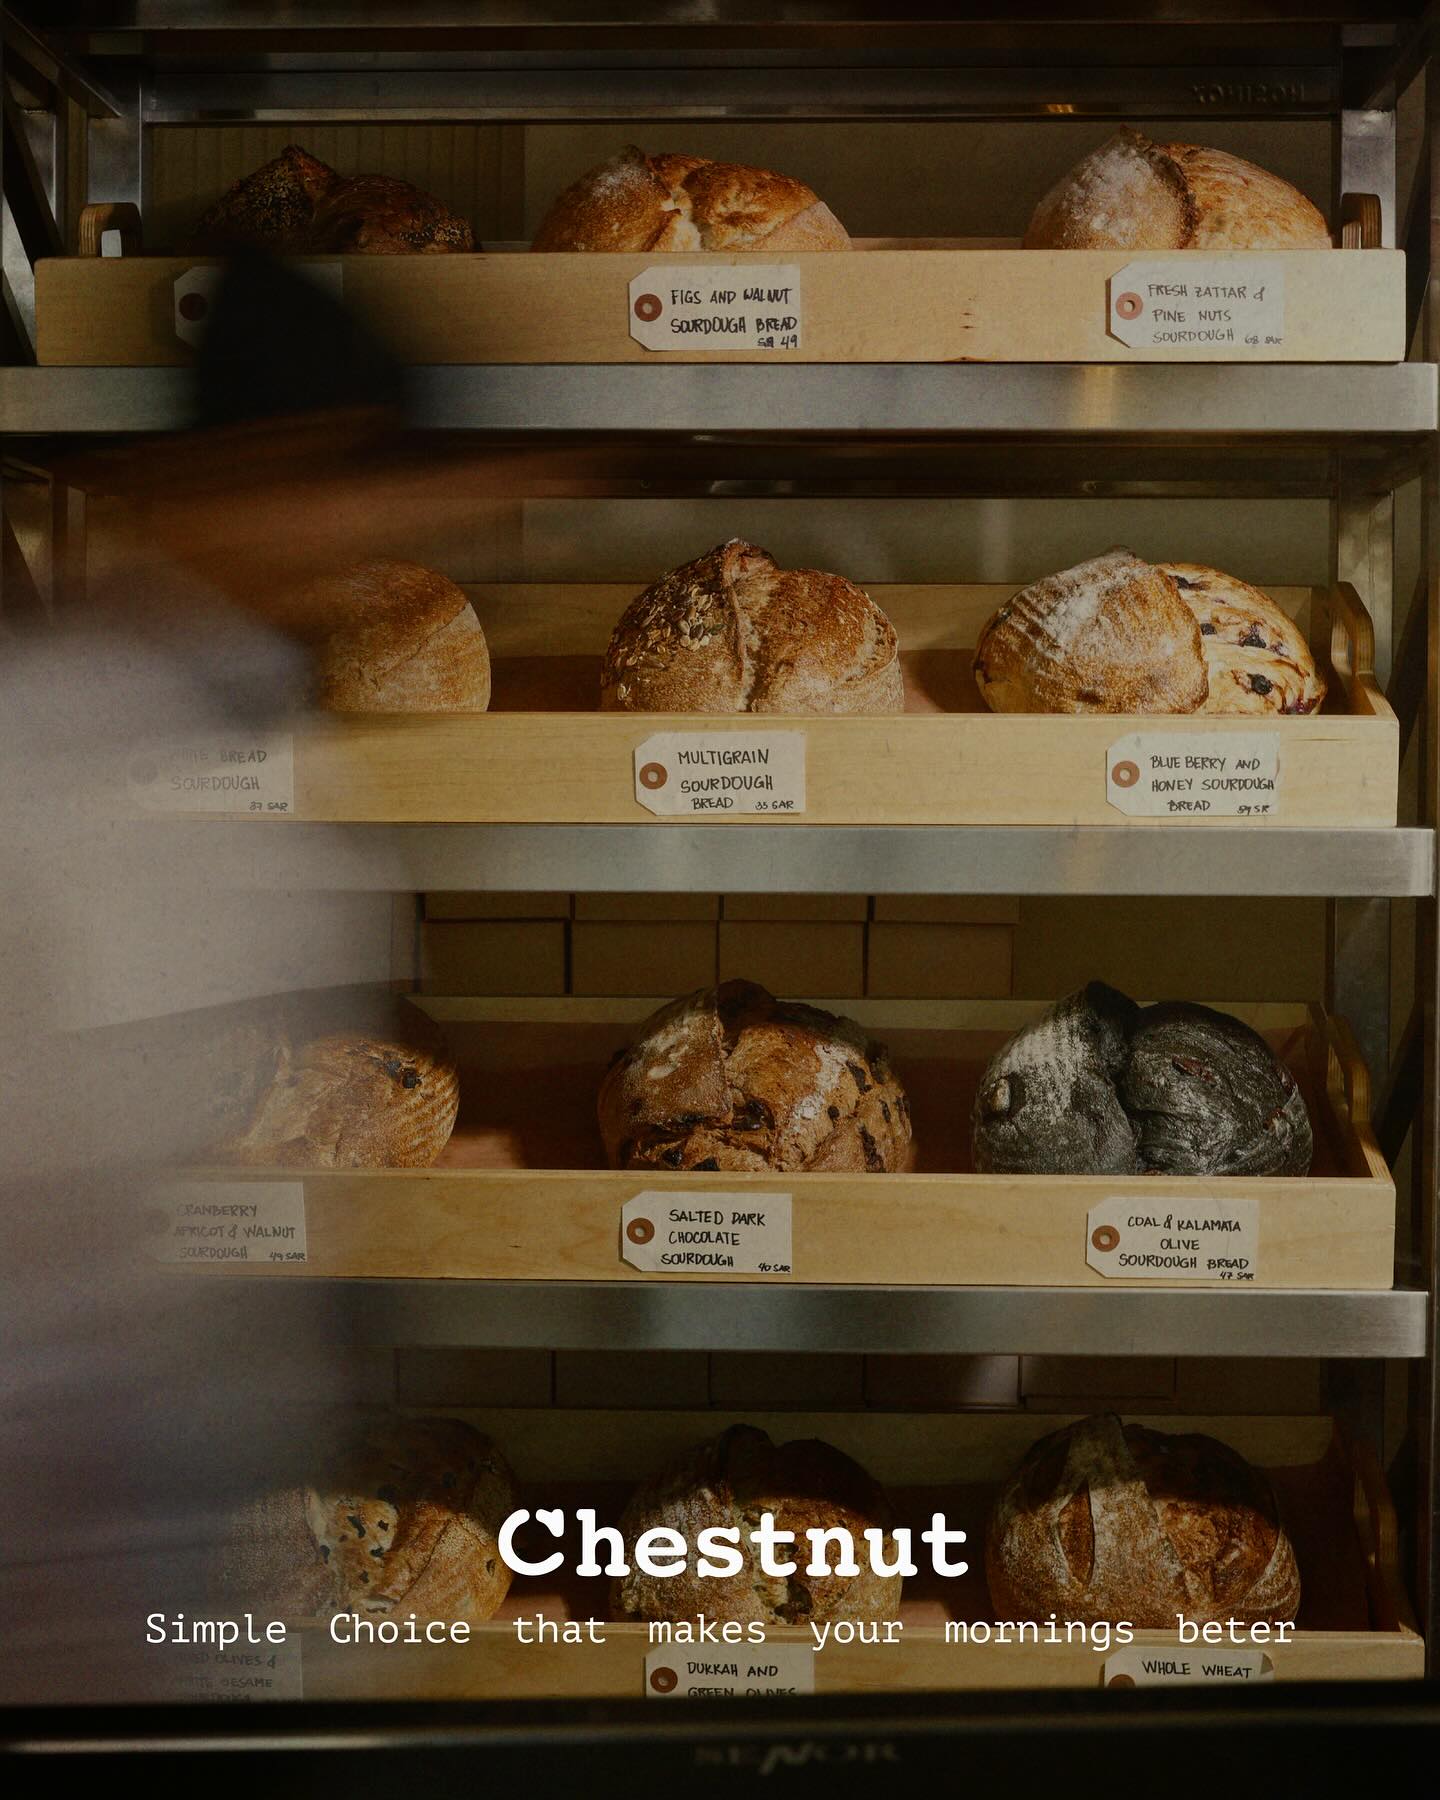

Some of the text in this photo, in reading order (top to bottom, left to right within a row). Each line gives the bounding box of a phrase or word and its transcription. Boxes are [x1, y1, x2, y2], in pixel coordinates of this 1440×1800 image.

[671, 287, 793, 305] FIGS AND WALNUT
[1148, 284, 1188, 297] FRESH
[1194, 285, 1247, 299] ZATTAR
[1152, 309, 1232, 323] PINE NUTS
[670, 316, 798, 335] SOURDOUGH BREAD
[780, 334, 798, 350] 49
[1152, 328, 1234, 344] SOURDOUGH
[678, 748, 769, 766] MULTIGRAIN
[1235, 758, 1261, 770] AND
[171, 775, 260, 791] SOURDOUGH
[680, 774, 774, 794] SOURDOUGH
[1151, 777, 1274, 792] HONEY SOURDOUGH
[691, 797, 734, 810] BREAD
[1167, 800, 1211, 812] BREAD
[668, 1209, 766, 1227] SALTED DARK
[1127, 1214, 1241, 1232] COAL & KALAMATA
[173, 1224, 296, 1240] APRICOT & WALNUT
[668, 1231, 741, 1246] CHOCOLATE
[1160, 1238, 1200, 1250] OLIVE
[178, 1245, 248, 1260] SOURDOUGH
[285, 1252, 307, 1261] SAR
[660, 1252, 734, 1267] SOURDOUGH
[1118, 1253, 1249, 1270] SOURDOUGH BREAD
[686, 1662, 778, 1677] DUKKAH AND
[1141, 1660, 1252, 1679] WHOLE WHEAT
